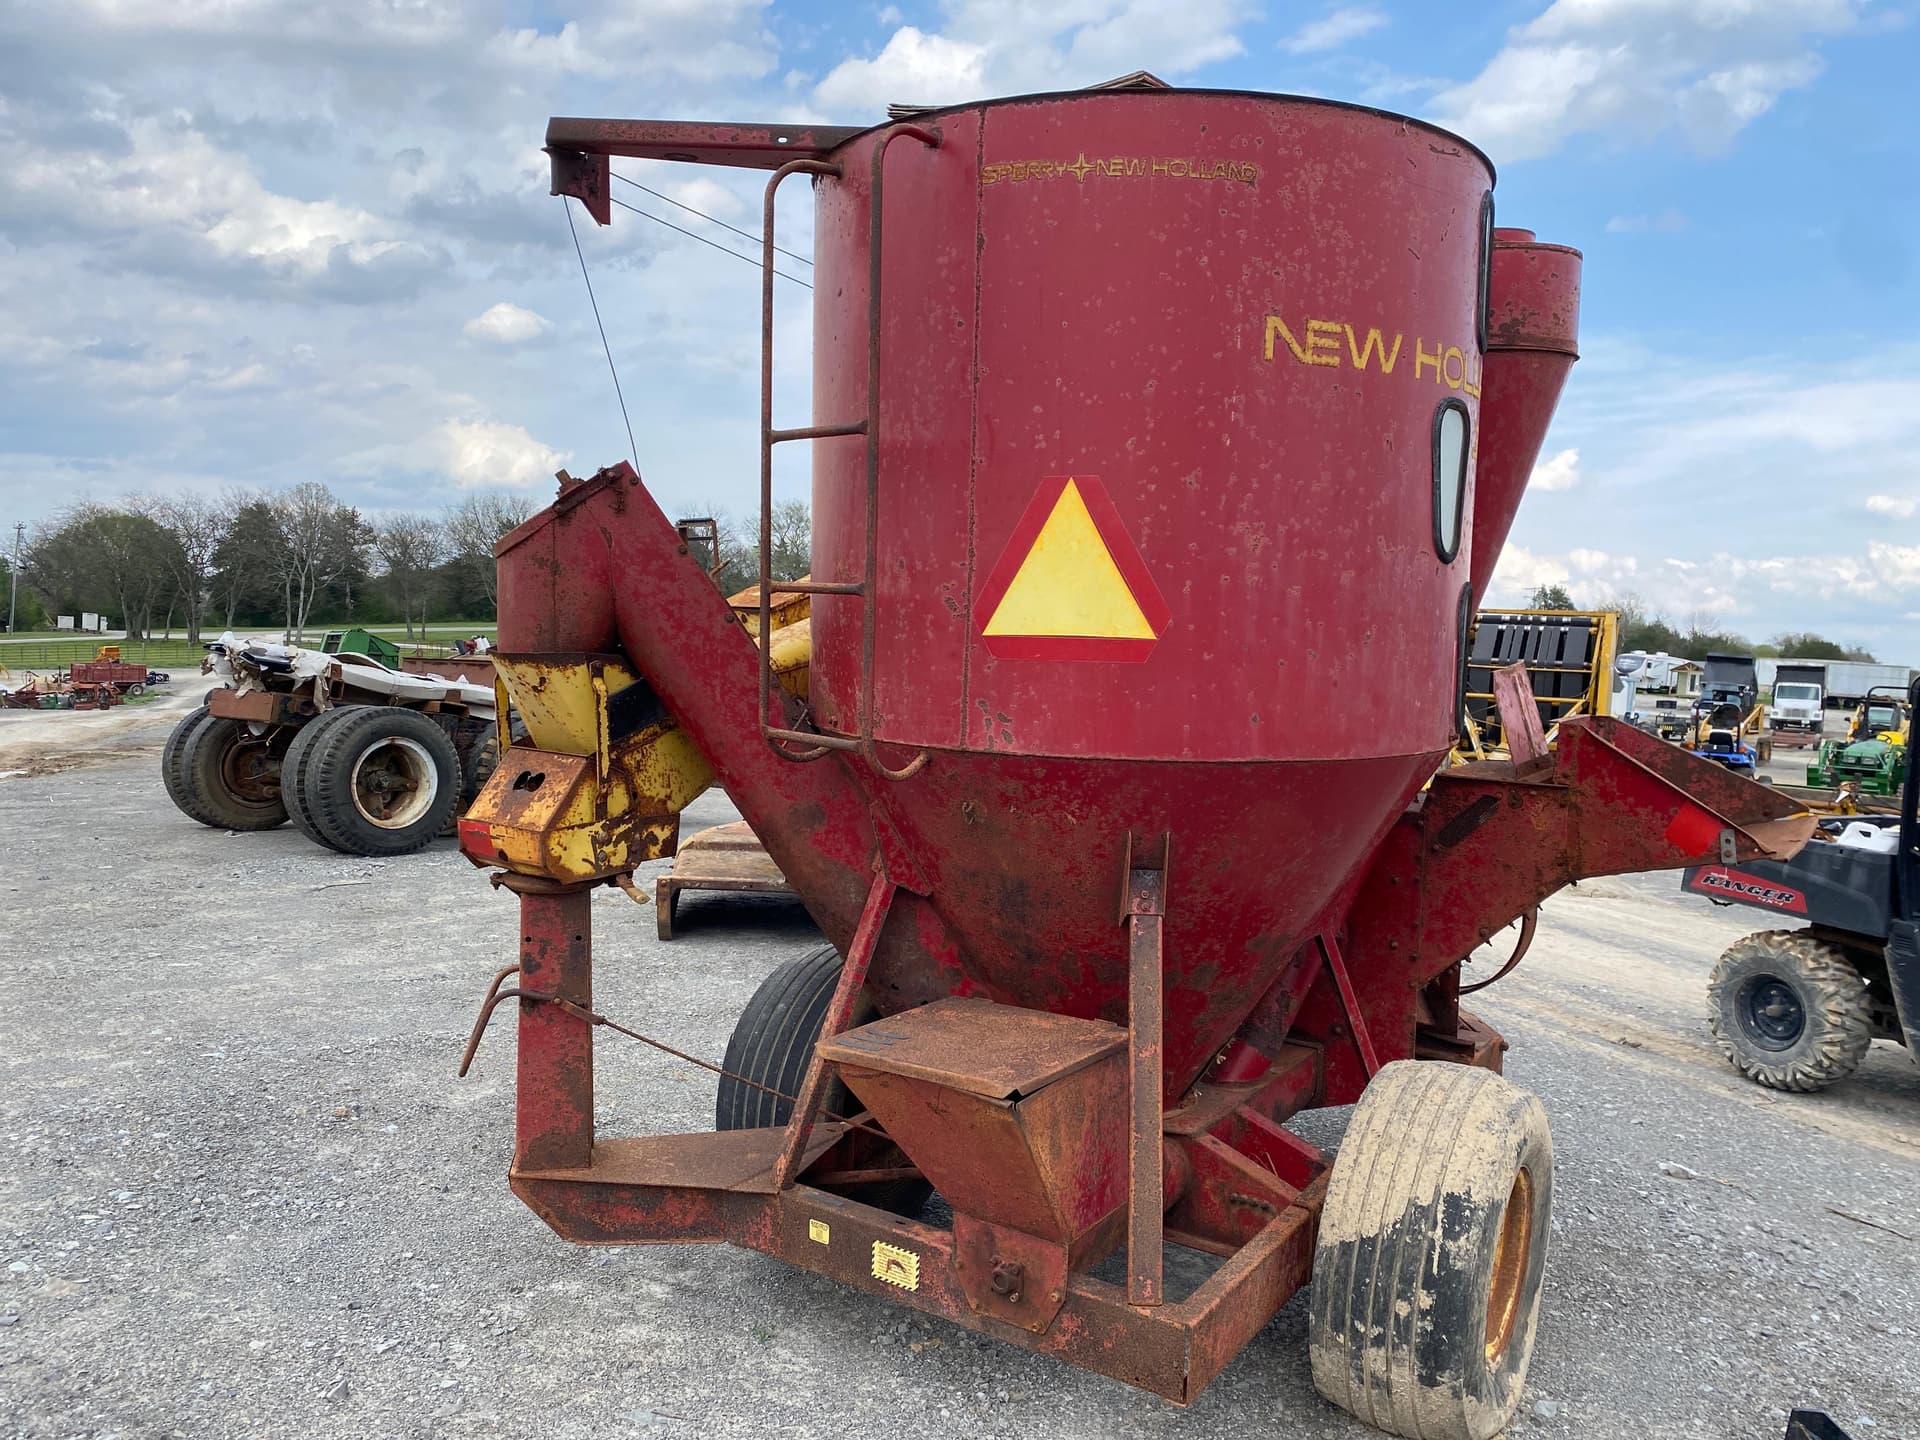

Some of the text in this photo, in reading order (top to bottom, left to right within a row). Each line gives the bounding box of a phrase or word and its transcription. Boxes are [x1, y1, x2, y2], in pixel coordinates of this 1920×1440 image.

[1096, 158, 1146, 177] NEW
[1151, 157, 1257, 183] HOLLAND
[1264, 315, 1403, 374] NEW
[1701, 874, 1795, 903] RANGER
